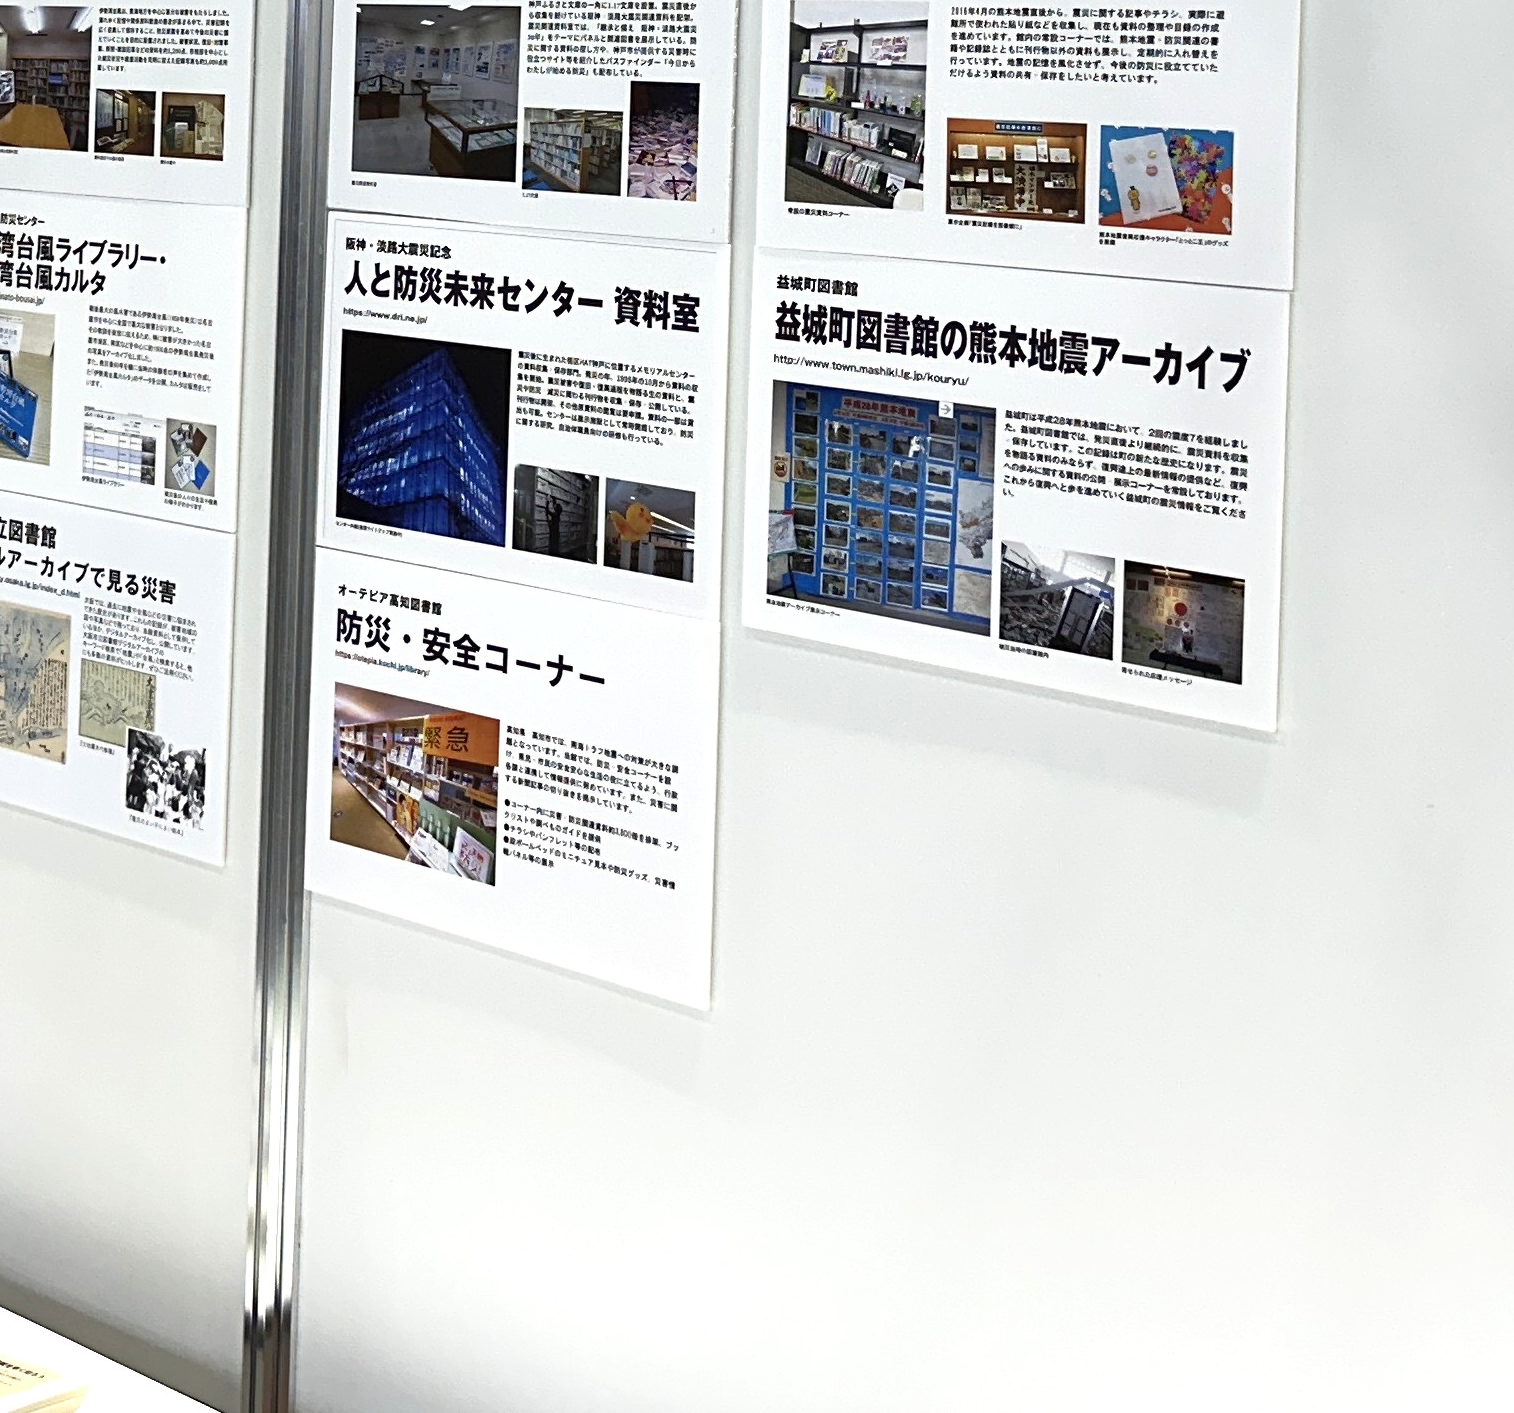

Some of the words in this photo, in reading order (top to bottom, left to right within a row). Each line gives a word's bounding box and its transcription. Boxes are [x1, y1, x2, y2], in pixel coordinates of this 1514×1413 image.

[346, 237, 451, 260] 阪神・淡路大震災記念
[344, 260, 603, 318] 人と防災未来センター
[614, 286, 700, 332] 資料室
[777, 274, 858, 297] 益城町図書館
[775, 301, 1251, 393] 益城町図書館の熊本地震アーカイブ
[774, 354, 969, 386] http://www.town.mashiki.lg.jp/kouryu/
[338, 584, 441, 616] オーテピア高知図書館
[336, 609, 605, 687] 防災・安全コーナー
[423, 725, 469, 753] 緊急
